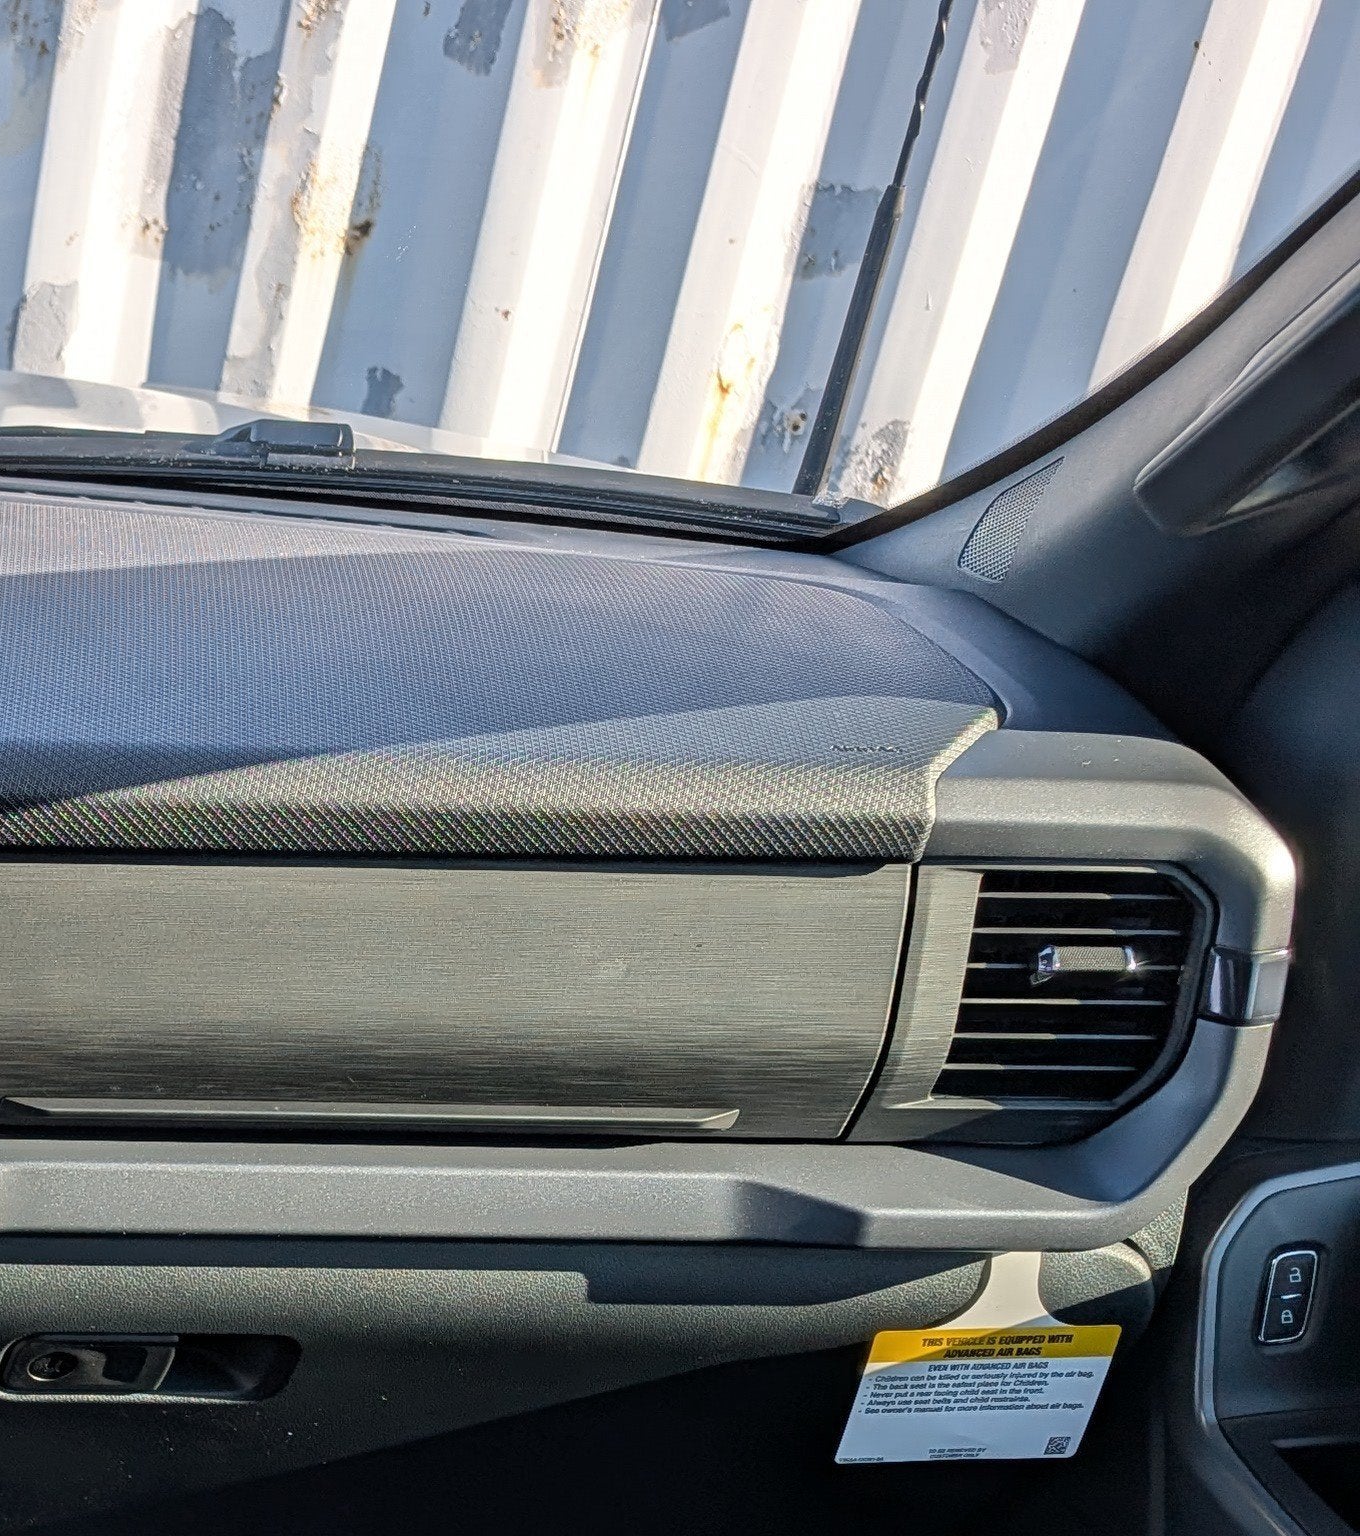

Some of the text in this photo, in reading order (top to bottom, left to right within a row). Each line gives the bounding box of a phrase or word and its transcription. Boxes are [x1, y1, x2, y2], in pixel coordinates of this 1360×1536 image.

[922, 1334, 1074, 1347] THIS VEHICLE IS EQUIPPED WITH
[943, 1347, 1042, 1358] ADVANCED AIR BAGS
[928, 1361, 1049, 1372] EVEN WITH ADVANCED AIR BAGS
